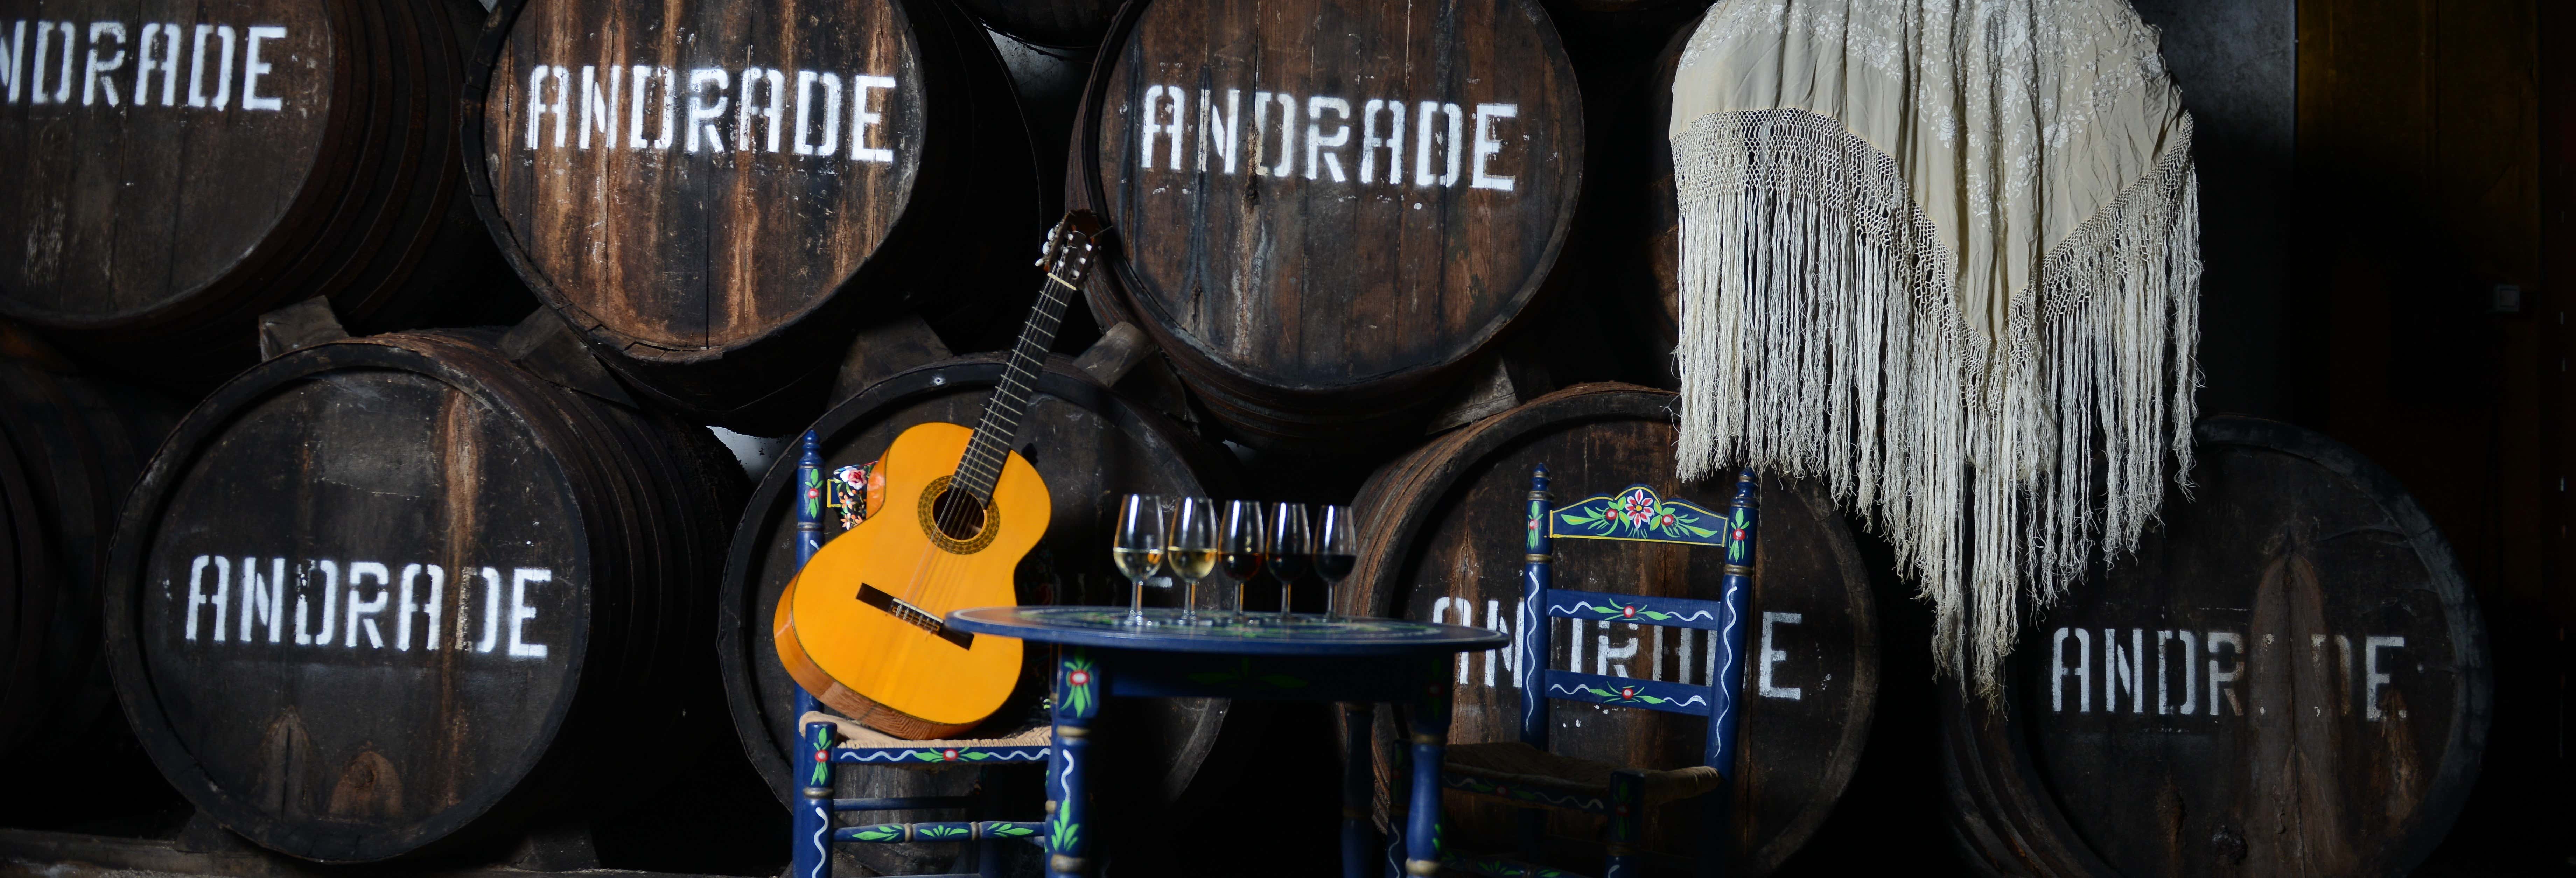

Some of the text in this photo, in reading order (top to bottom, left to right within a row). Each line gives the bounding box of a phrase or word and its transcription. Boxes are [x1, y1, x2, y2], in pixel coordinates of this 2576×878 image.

[527, 64, 896, 163] ANDRADE
[1140, 84, 1518, 192] ANDRADE
[186, 555, 552, 659] ANDRADE
[2052, 627, 2407, 722] ANDRDE
